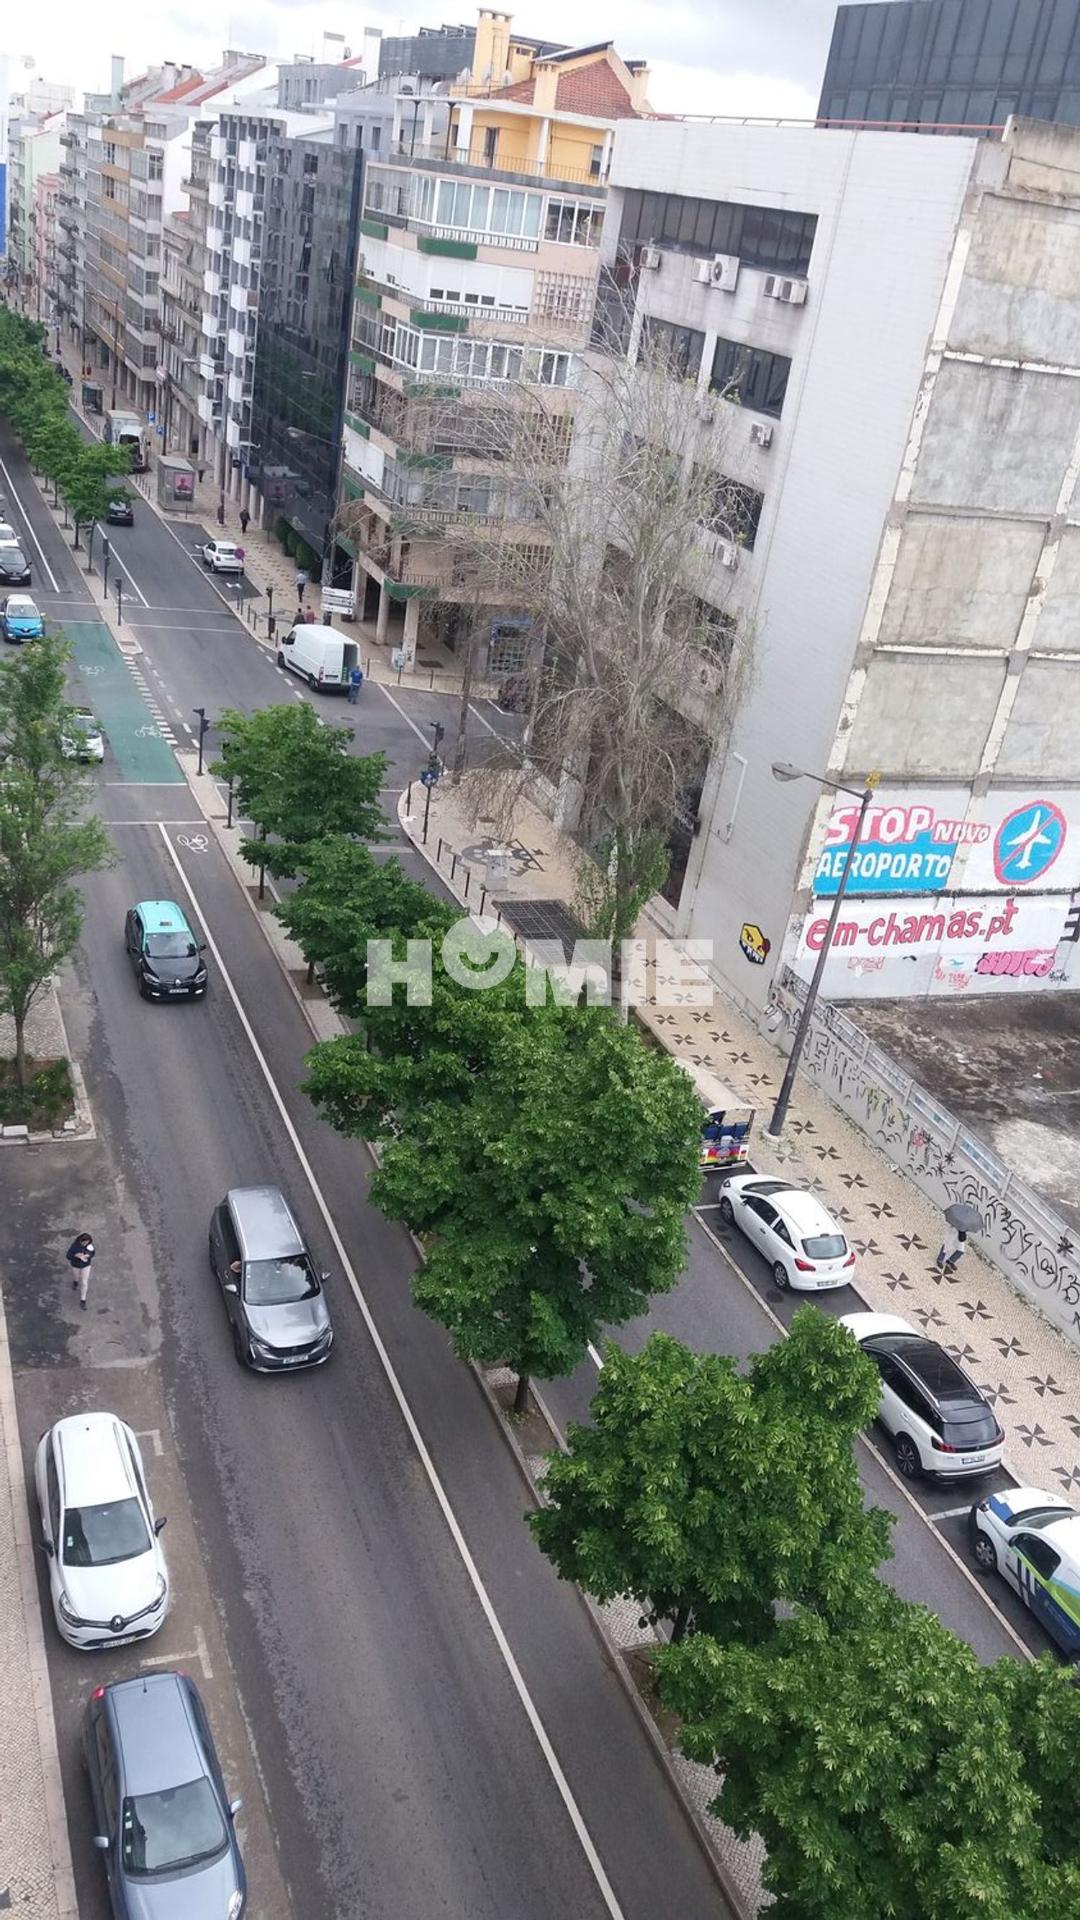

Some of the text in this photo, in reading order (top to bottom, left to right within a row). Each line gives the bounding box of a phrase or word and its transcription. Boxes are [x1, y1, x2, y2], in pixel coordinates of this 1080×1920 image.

[825, 807, 935, 846] STOP
[815, 850, 951, 878] AEROPORTO
[805, 898, 1018, 950] em-chamas.pt
